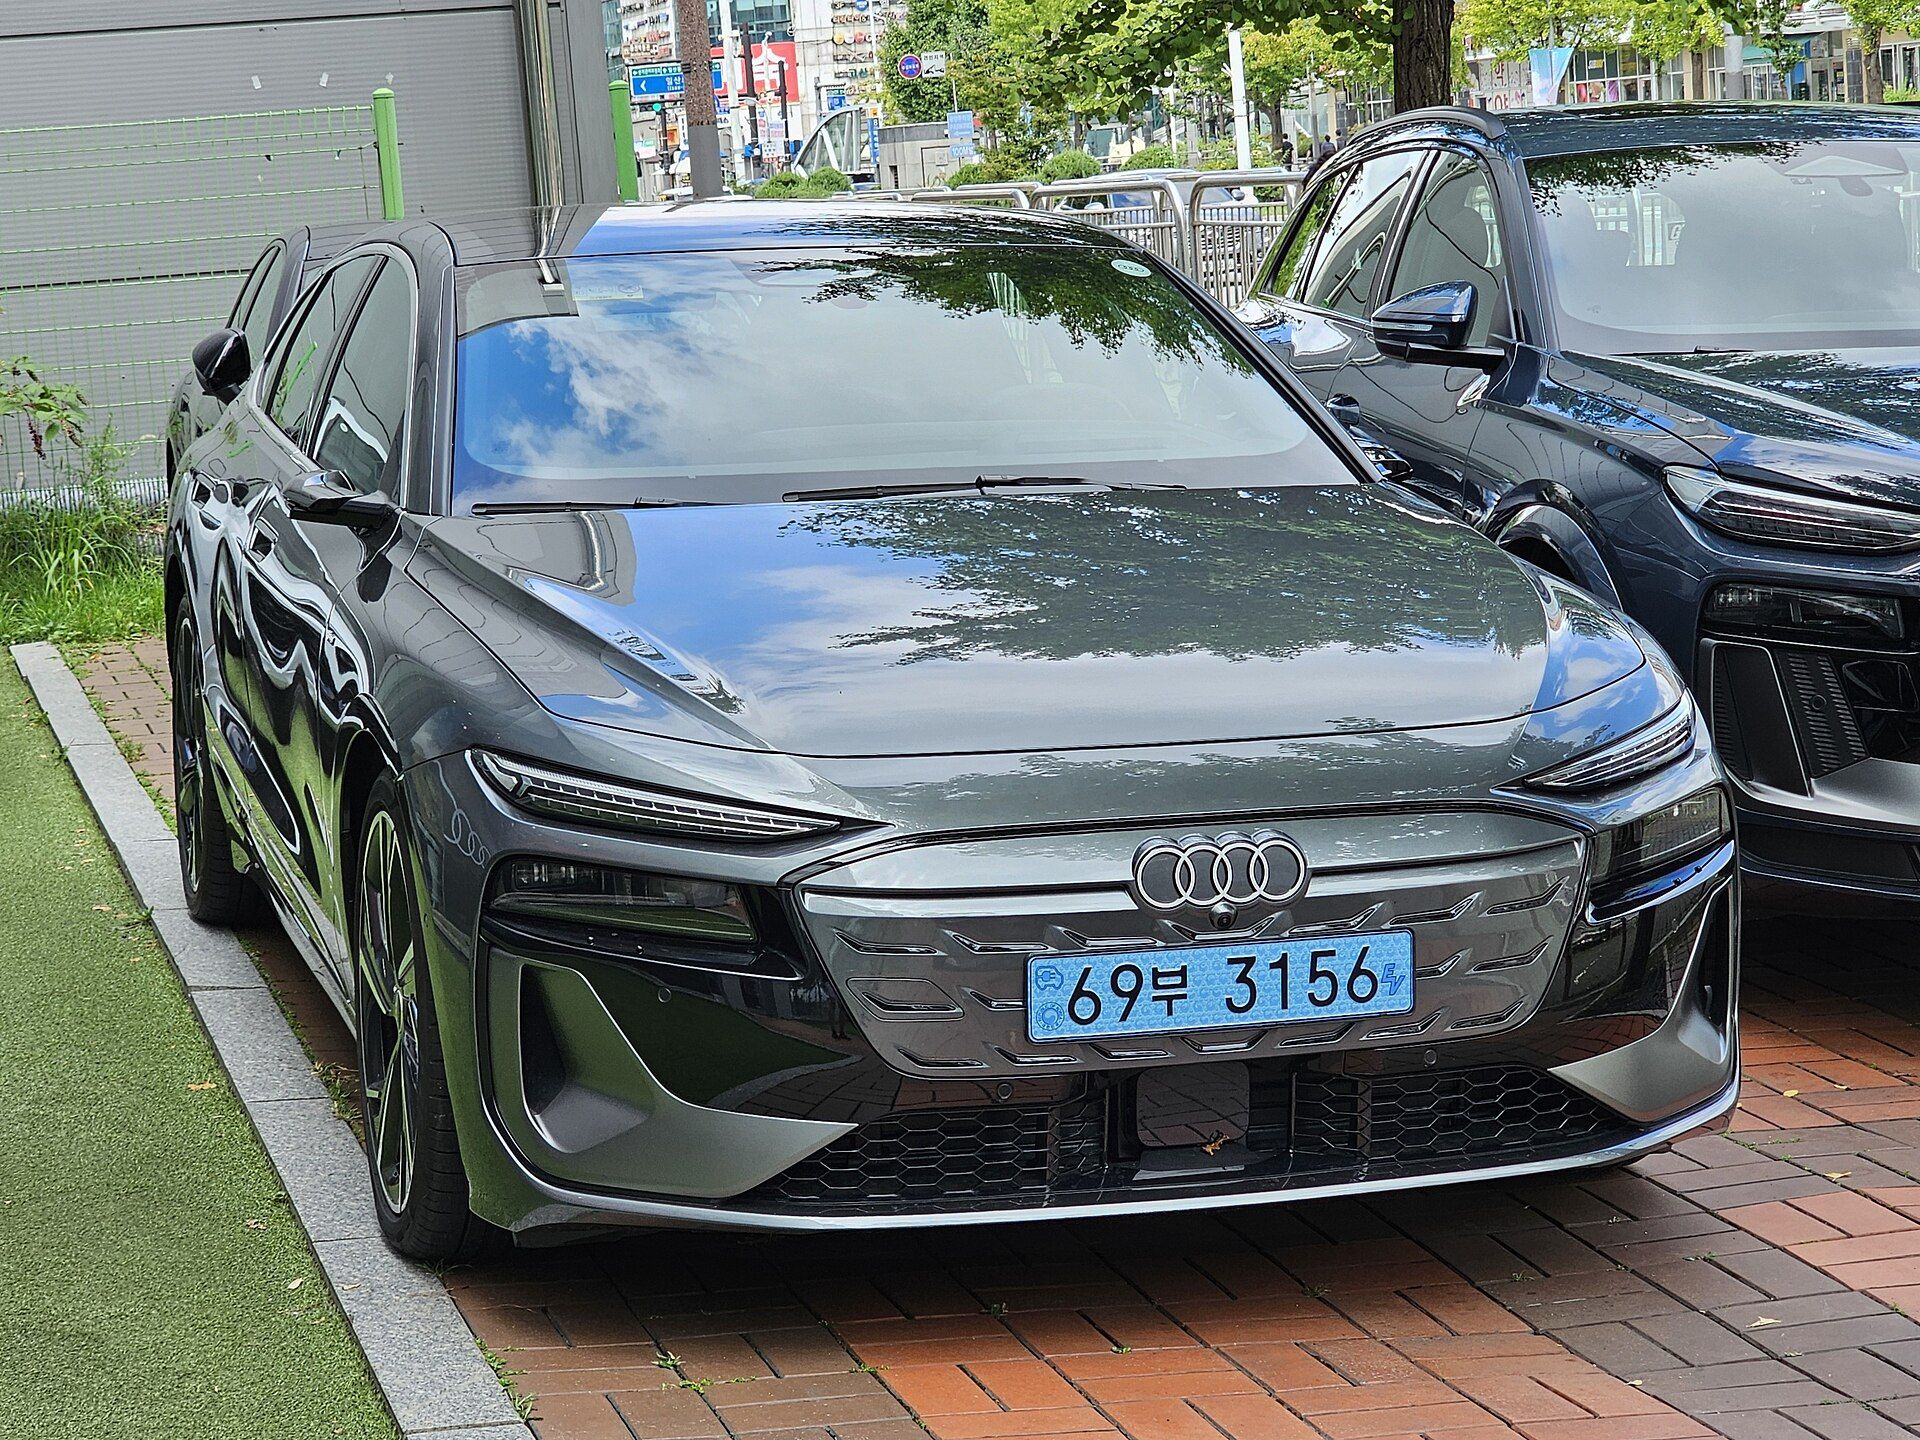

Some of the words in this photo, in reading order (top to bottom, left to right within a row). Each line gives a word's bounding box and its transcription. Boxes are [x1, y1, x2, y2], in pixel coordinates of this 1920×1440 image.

[666, 76, 684, 86] 일산
[1068, 964, 1189, 1026] 69부
[1225, 946, 1380, 1014] 3156
[1381, 963, 1406, 996] EV
